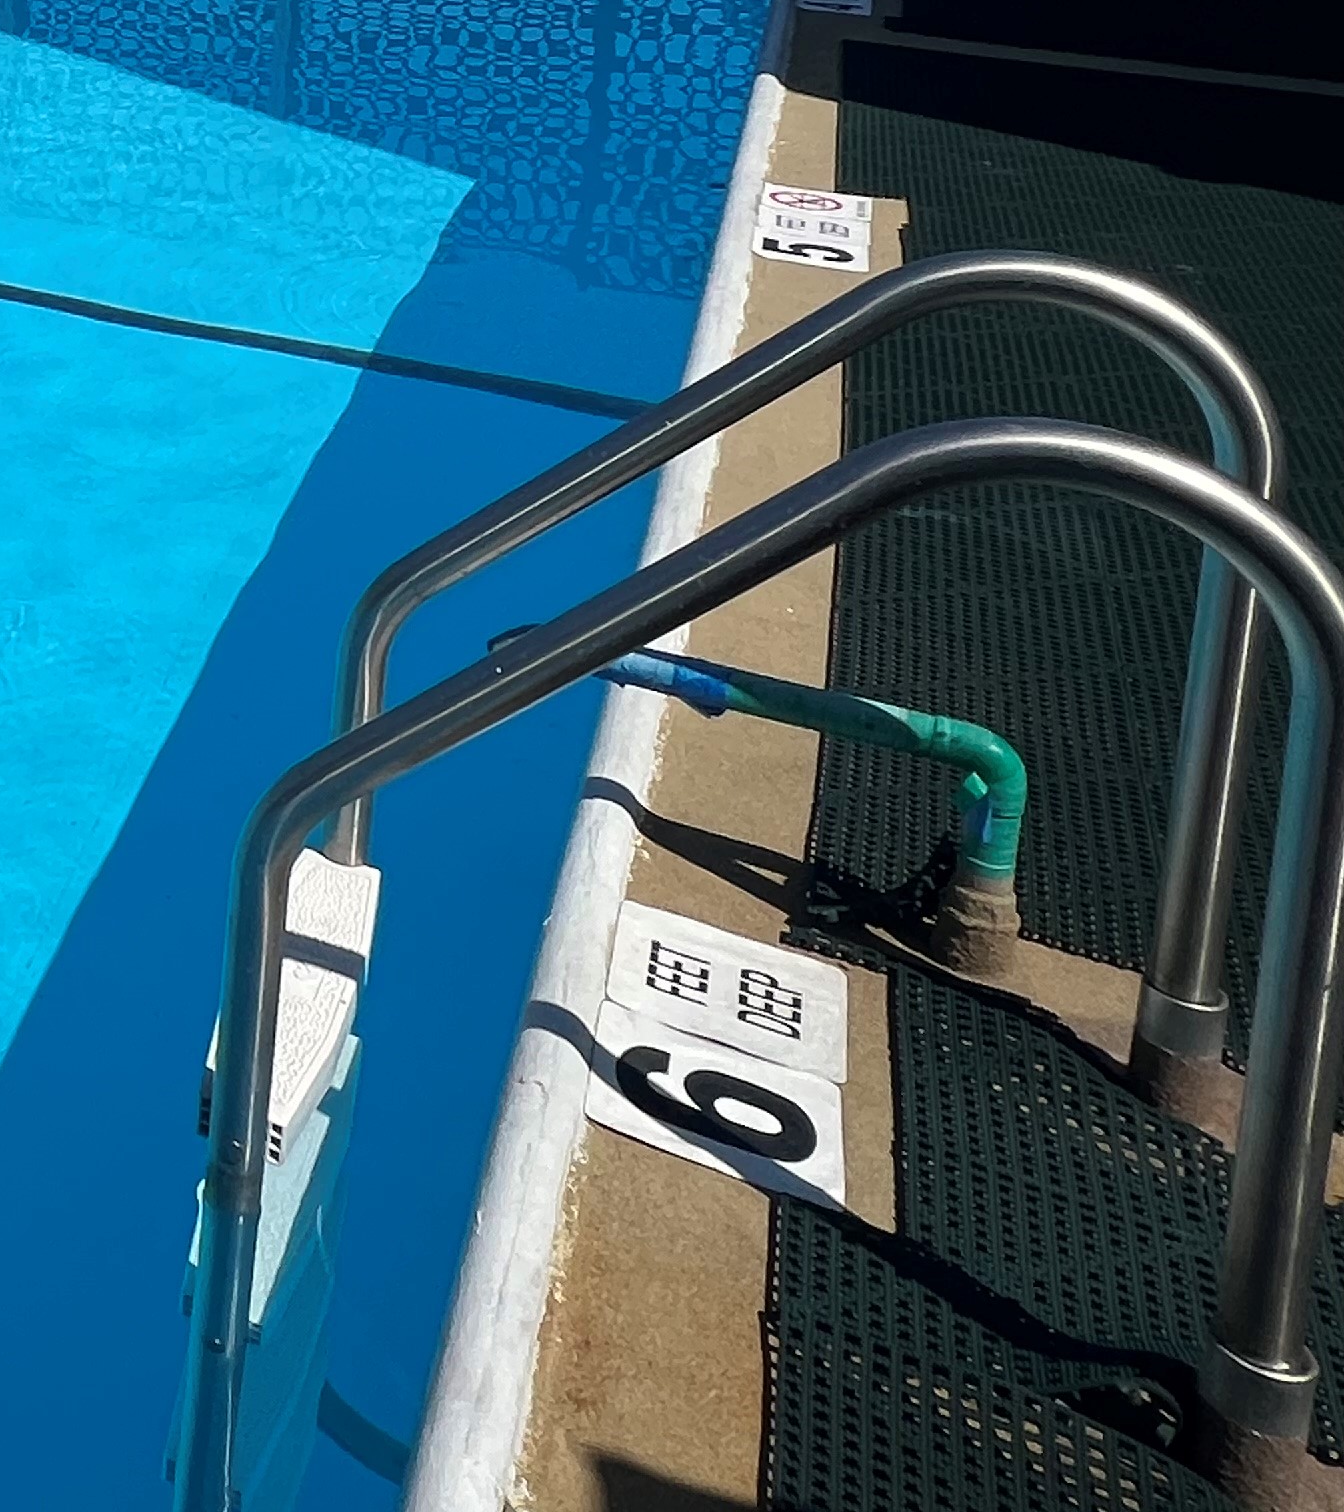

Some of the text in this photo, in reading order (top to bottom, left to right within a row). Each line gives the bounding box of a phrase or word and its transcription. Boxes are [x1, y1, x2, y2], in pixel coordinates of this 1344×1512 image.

[762, 237, 855, 263] 5
[645, 939, 711, 1007] FEET
[737, 968, 803, 1040] DEEP
[616, 1045, 817, 1163] 6
